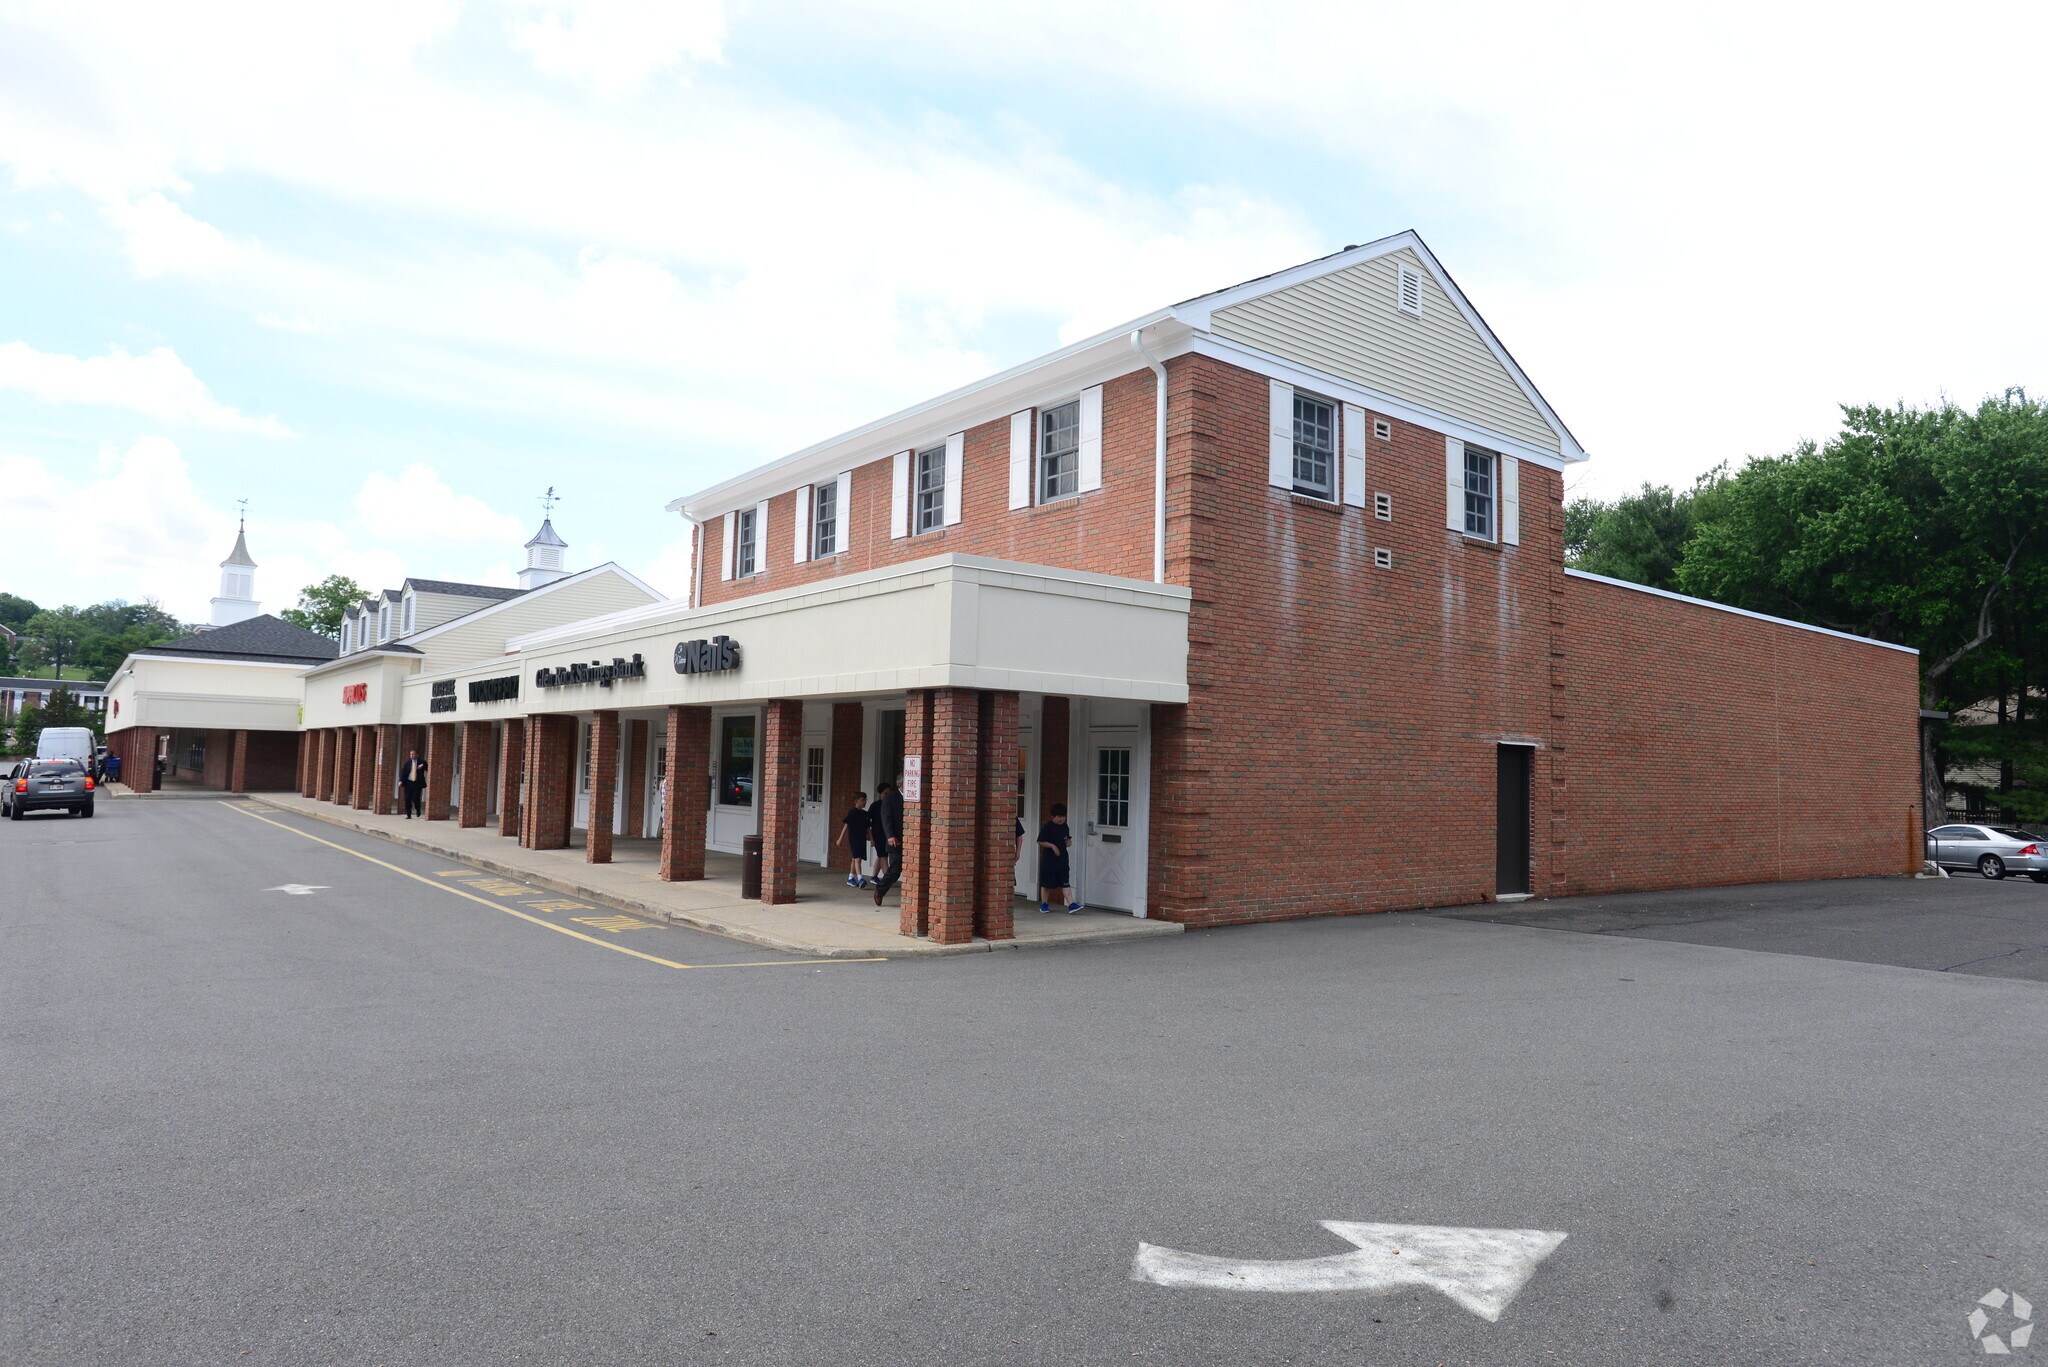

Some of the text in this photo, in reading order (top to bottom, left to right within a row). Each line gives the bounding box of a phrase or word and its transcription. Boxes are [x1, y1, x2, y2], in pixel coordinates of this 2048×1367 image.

[555, 664, 577, 685] Rock
[576, 660, 613, 687] Savings
[612, 653, 645, 681] Bank
[687, 635, 740, 673] Nails
